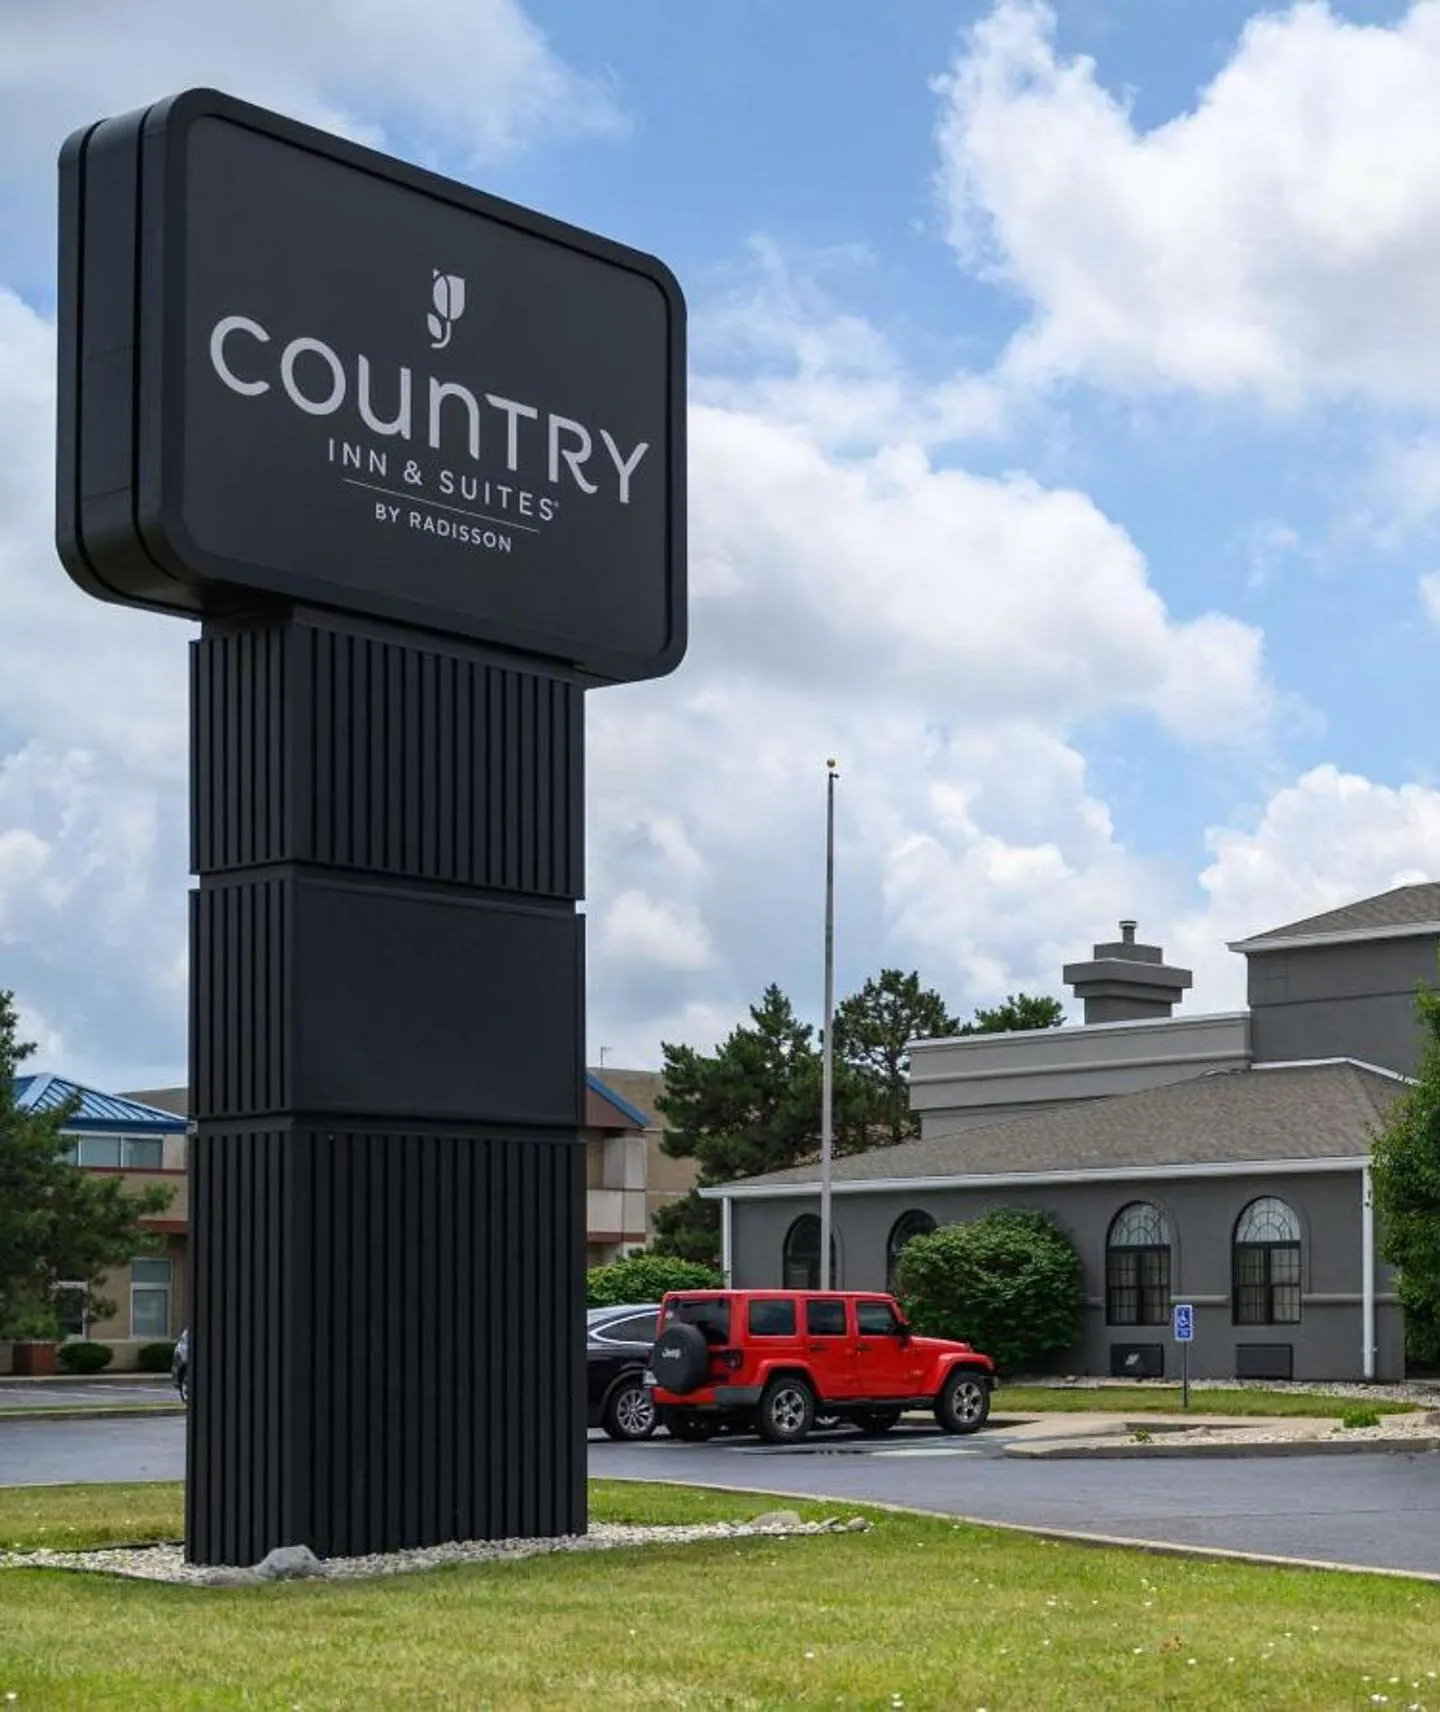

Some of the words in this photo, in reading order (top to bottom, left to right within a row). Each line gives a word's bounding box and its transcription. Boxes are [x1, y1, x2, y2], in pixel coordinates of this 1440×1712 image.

[328, 437, 387, 477] INN
[403, 459, 424, 486] &
[439, 469, 557, 521] SUITES
[375, 502, 400, 524] BY
[409, 511, 512, 552] RADISSON
